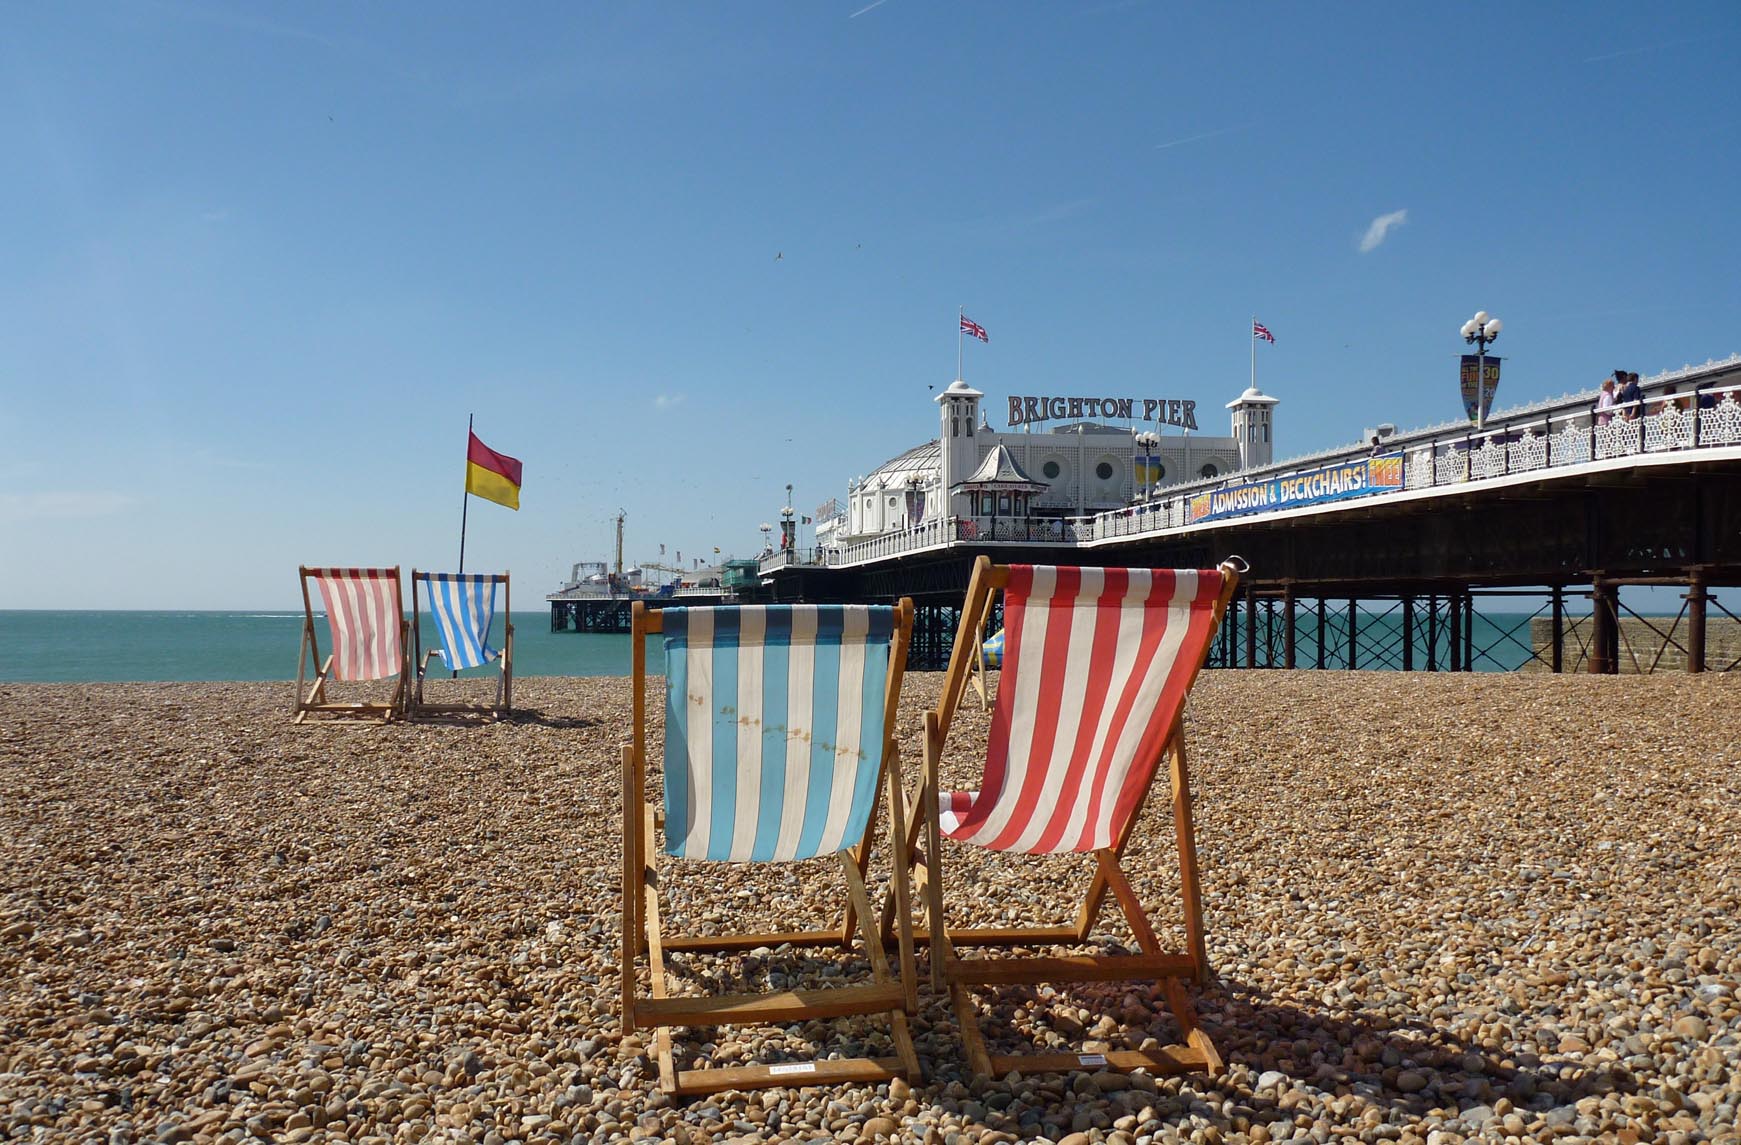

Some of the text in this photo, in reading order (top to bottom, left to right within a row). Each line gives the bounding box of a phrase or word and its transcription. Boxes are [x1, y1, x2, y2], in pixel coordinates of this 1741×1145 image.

[1007, 396, 1199, 430] BRIGHTON PIER
[1212, 483, 1267, 515] ADMISSION
[1270, 485, 1276, 501] &
[1280, 466, 1366, 501] DECKCHAIRS!
